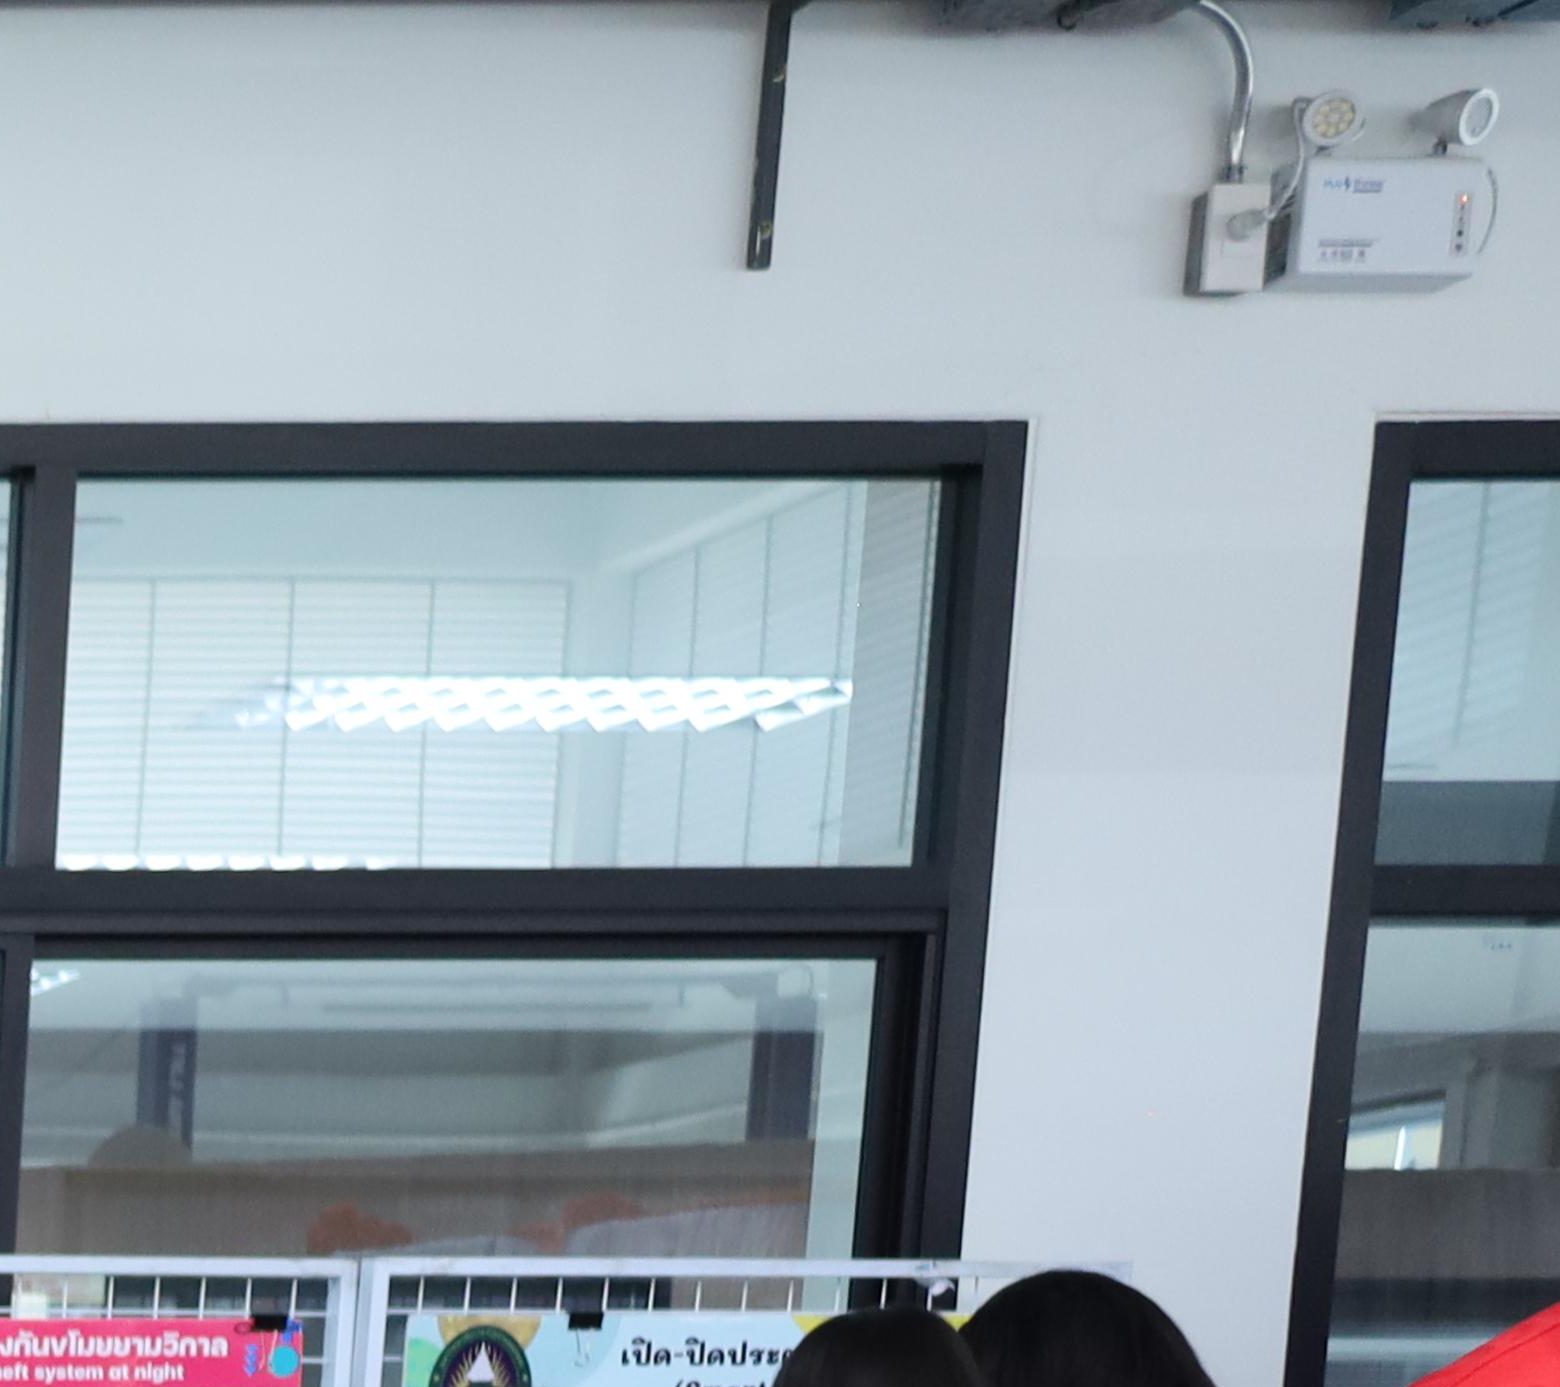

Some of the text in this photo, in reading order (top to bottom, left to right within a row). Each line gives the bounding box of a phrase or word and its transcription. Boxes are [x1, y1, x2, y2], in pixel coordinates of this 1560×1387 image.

[34, 1365, 105, 1383] system
[108, 1364, 130, 1381] at
[134, 1362, 185, 1383] night
